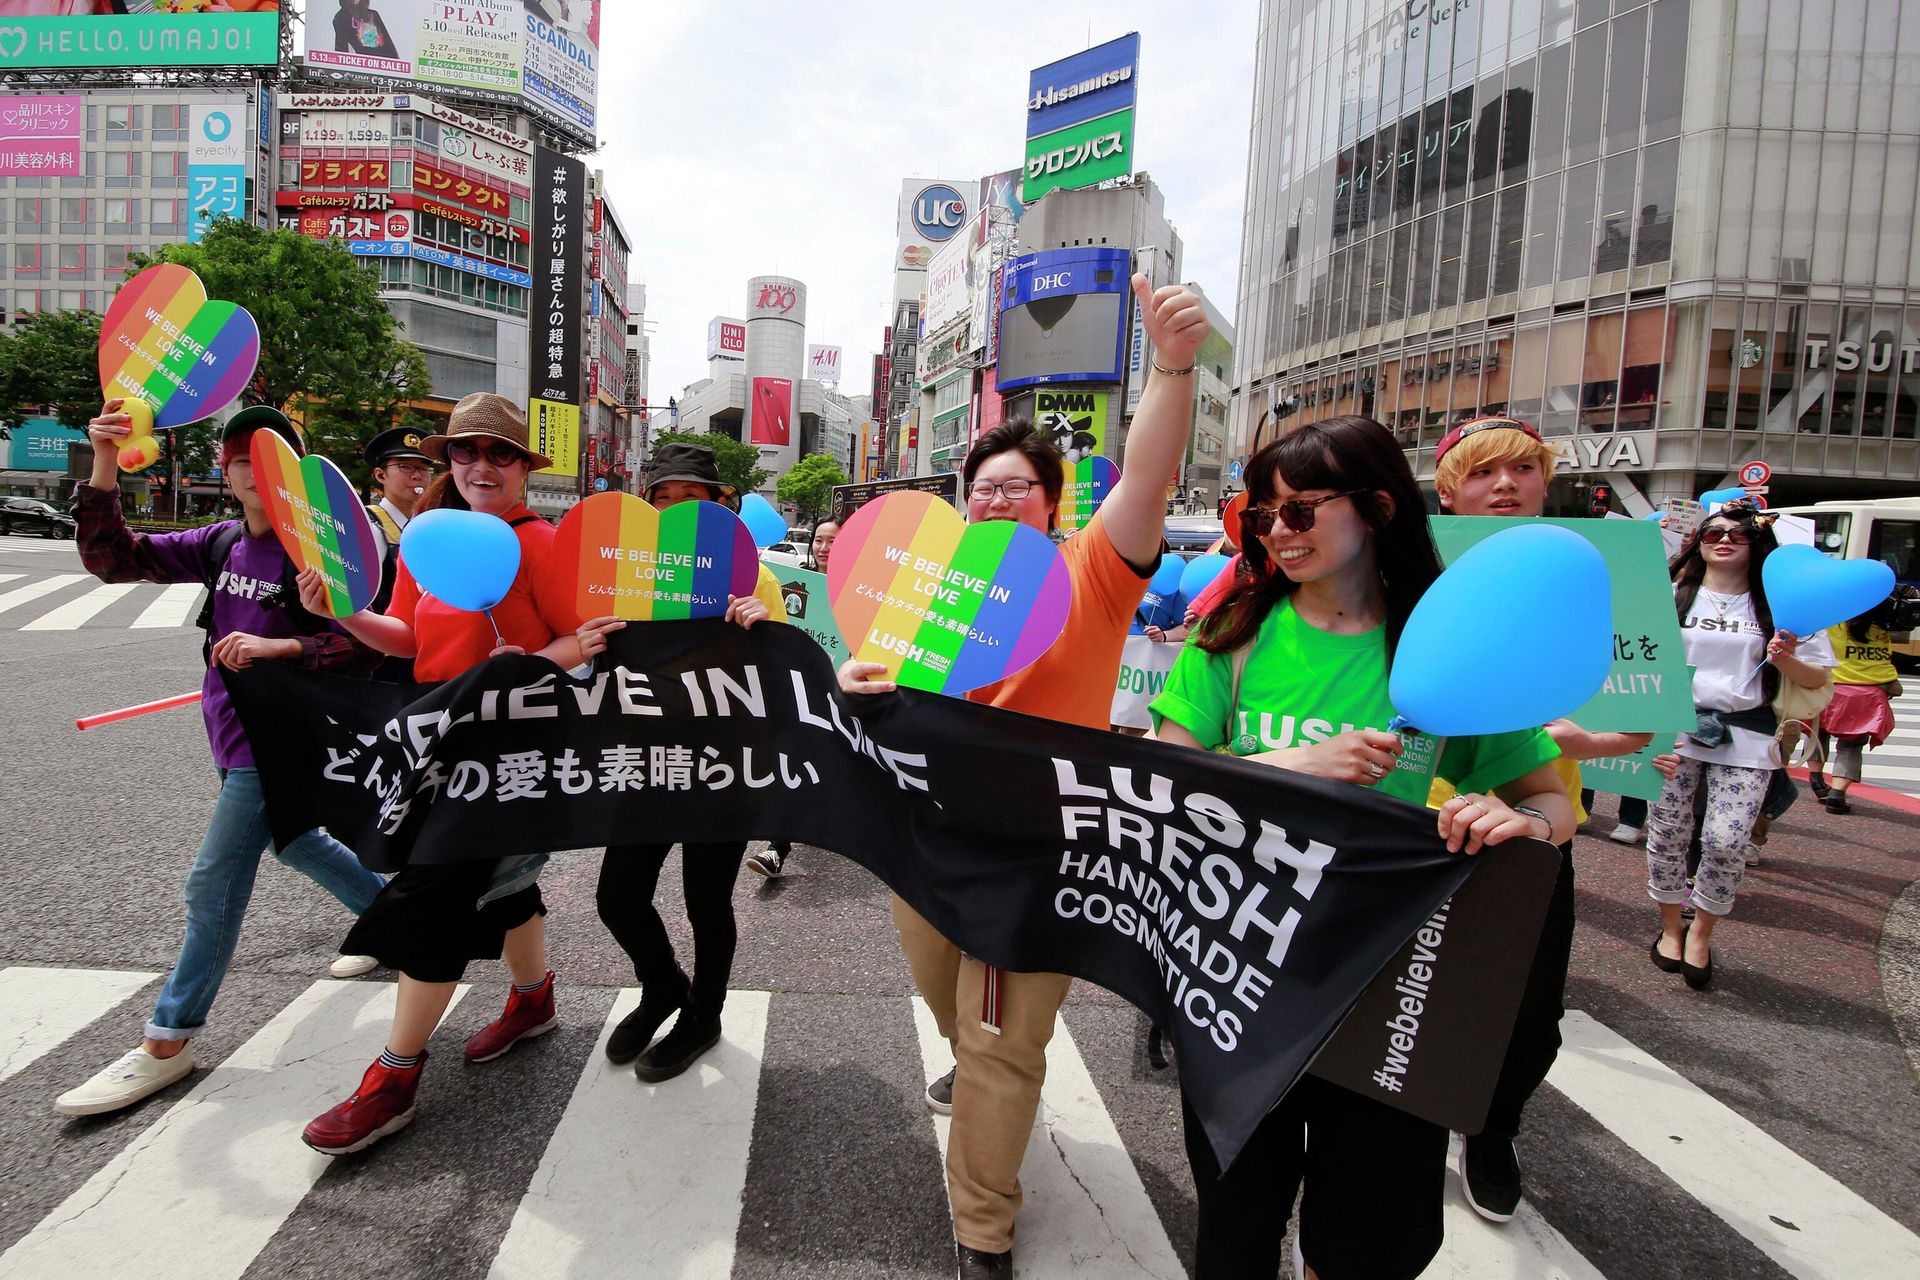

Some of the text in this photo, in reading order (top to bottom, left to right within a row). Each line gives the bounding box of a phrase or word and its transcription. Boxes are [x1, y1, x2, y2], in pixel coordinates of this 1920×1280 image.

[139, 28, 252, 52] UMAJO!
[526, 14, 595, 72] SCANDAL
[339, 55, 367, 67] TICKET
[367, 58, 380, 68] ON
[380, 60, 409, 72] SALE!!
[1026, 64, 1132, 110] Hisamitsu
[18, 103, 75, 117] 品川スキン
[291, 95, 385, 108] しゃぶしゃぶバイキング
[18, 118, 69, 131] クリニック
[282, 122, 299, 134] 9F
[431, 103, 529, 149] しゃぶしゃぶバイキング
[0, 151, 74, 169] 川美容外科
[195, 145, 239, 158] eyecity
[472, 141, 528, 176] しゃぶ葉
[1027, 130, 1123, 179] サロンパス
[303, 162, 387, 181] プライス
[414, 166, 507, 210] コンタクト
[353, 192, 395, 210] ガスト
[280, 218, 299, 232] 7F
[304, 218, 327, 229] Café
[329, 215, 380, 238] ガスト
[480, 217, 521, 241] ガスト
[417, 247, 446, 262] AEON
[1016, 258, 1038, 271] Channel
[452, 256, 530, 284] 英会話イーオン
[763, 284, 796, 292] SHIBUYA
[1033, 271, 1072, 293] DHC
[756, 289, 797, 315] 109
[144, 307, 217, 366] WE BELIEVE IN
[723, 326, 742, 338] UNI
[723, 338, 743, 349] QLO
[155, 335, 185, 362] LOVE
[812, 349, 839, 367] H&M
[1131, 328, 1144, 372] neon
[115, 370, 149, 399] LUSH
[1037, 393, 1096, 412] DMM
[540, 429, 546, 438] ON
[1067, 489, 1085, 497] LOVE
[276, 485, 346, 536] WE BELIEVE IN
[1061, 513, 1082, 521] LUSH
[300, 514, 328, 539] LOVE
[600, 546, 713, 569] WE BELIEVE IN
[635, 566, 675, 582] LOVE
[884, 545, 1011, 604] WE BELIEVE IN
[588, 583, 718, 605] どんなカタチの愛も素晴らしい
[913, 577, 961, 606] LOVE
[855, 583, 1000, 646] どんなカタチの愛も素晴らしい
[869, 627, 925, 663] LUSH
[1844, 645, 1892, 661] PRESS
[925, 650, 951, 666] FRESH
[680, 664, 767, 718] IN
[1051, 757, 1338, 902] LUSH
[1060, 804, 1303, 969] FRESH
[1058, 850, 1274, 1013] HANDMADE
[1054, 887, 1244, 1053] COSMETICS
